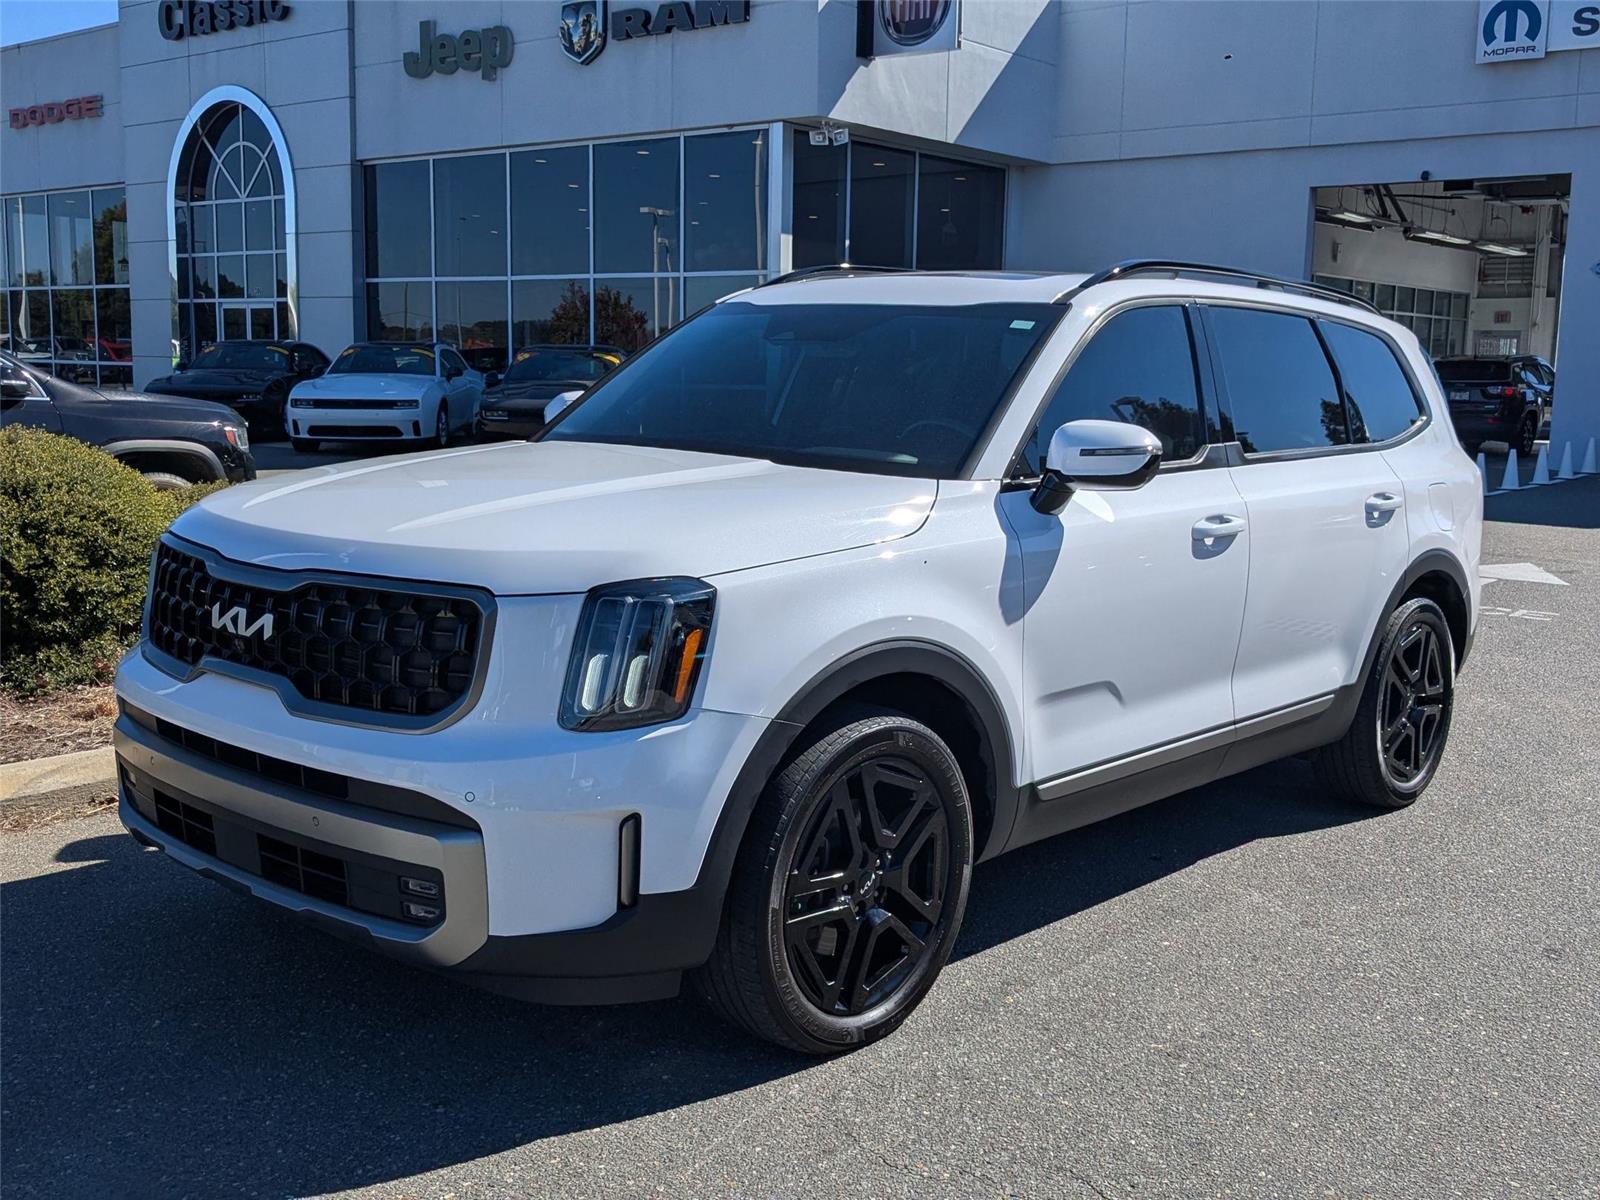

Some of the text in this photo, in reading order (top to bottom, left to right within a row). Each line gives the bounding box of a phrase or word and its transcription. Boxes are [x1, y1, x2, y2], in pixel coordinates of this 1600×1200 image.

[158, 0, 290, 41] Classic
[611, 0, 750, 41] RAM
[403, 20, 514, 81] Jeep
[1483, 45, 1537, 57] MOPAR
[8, 94, 104, 130] DODGE
